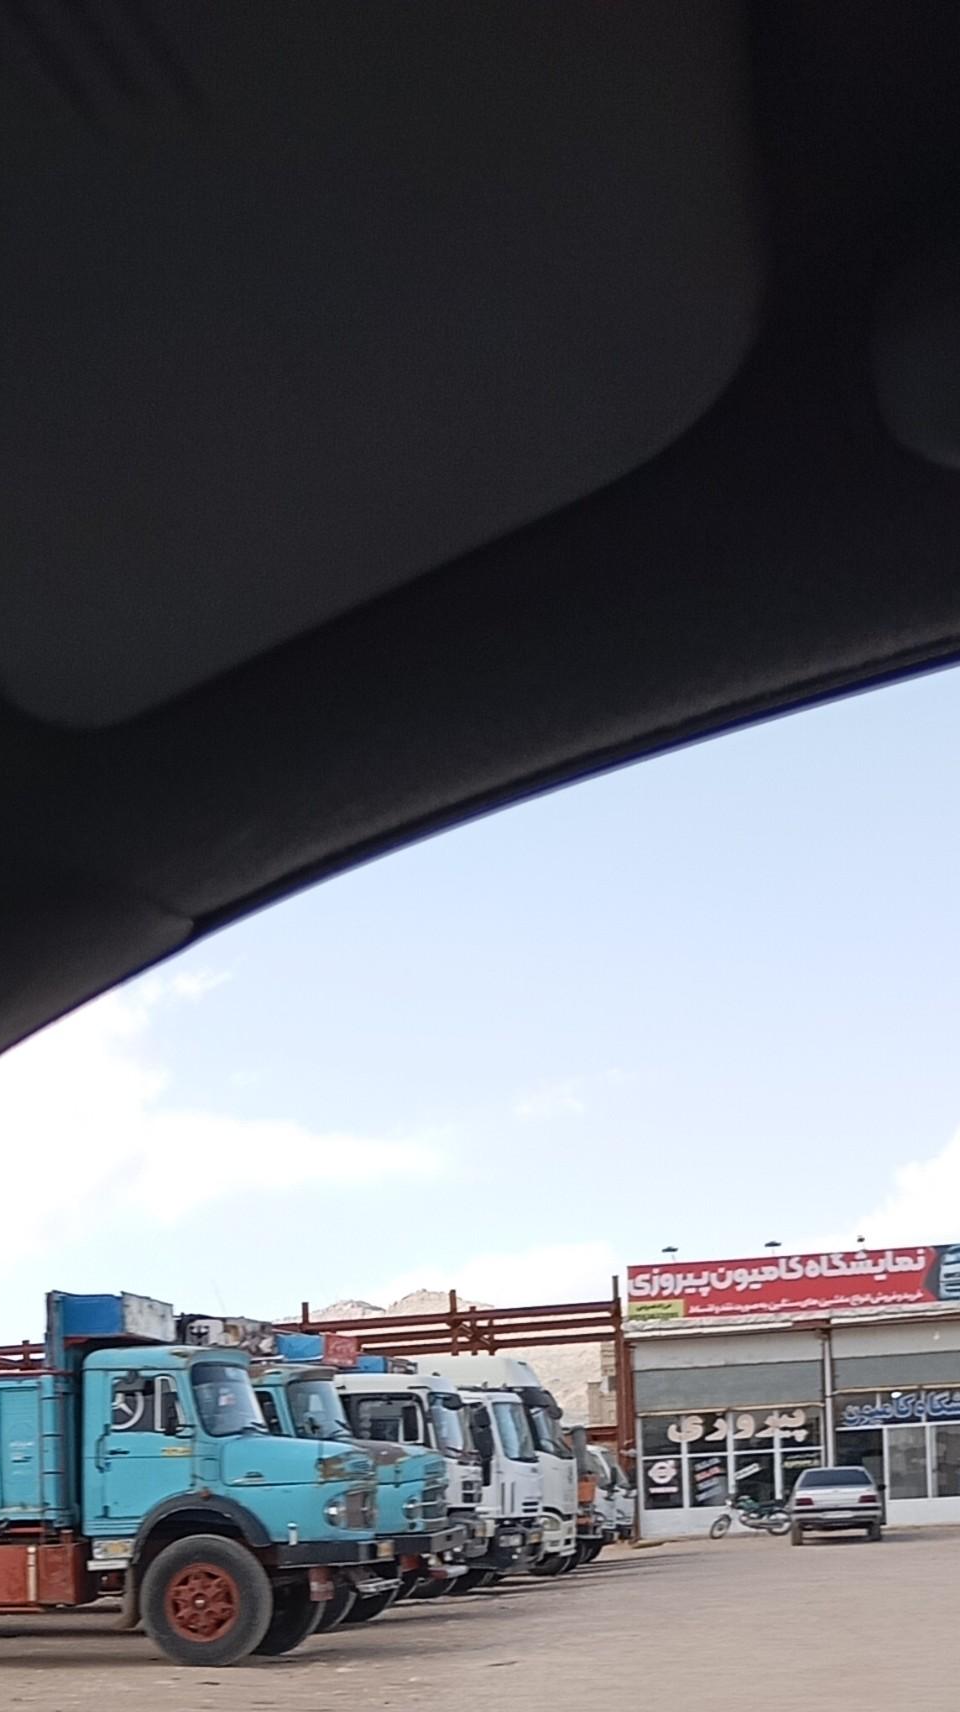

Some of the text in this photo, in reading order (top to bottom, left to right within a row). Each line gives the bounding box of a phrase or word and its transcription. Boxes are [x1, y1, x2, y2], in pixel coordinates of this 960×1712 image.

[628, 1249, 926, 1297] نمایشگاه کامیون پیروزی
[667, 1408, 808, 1443] پیروزی
